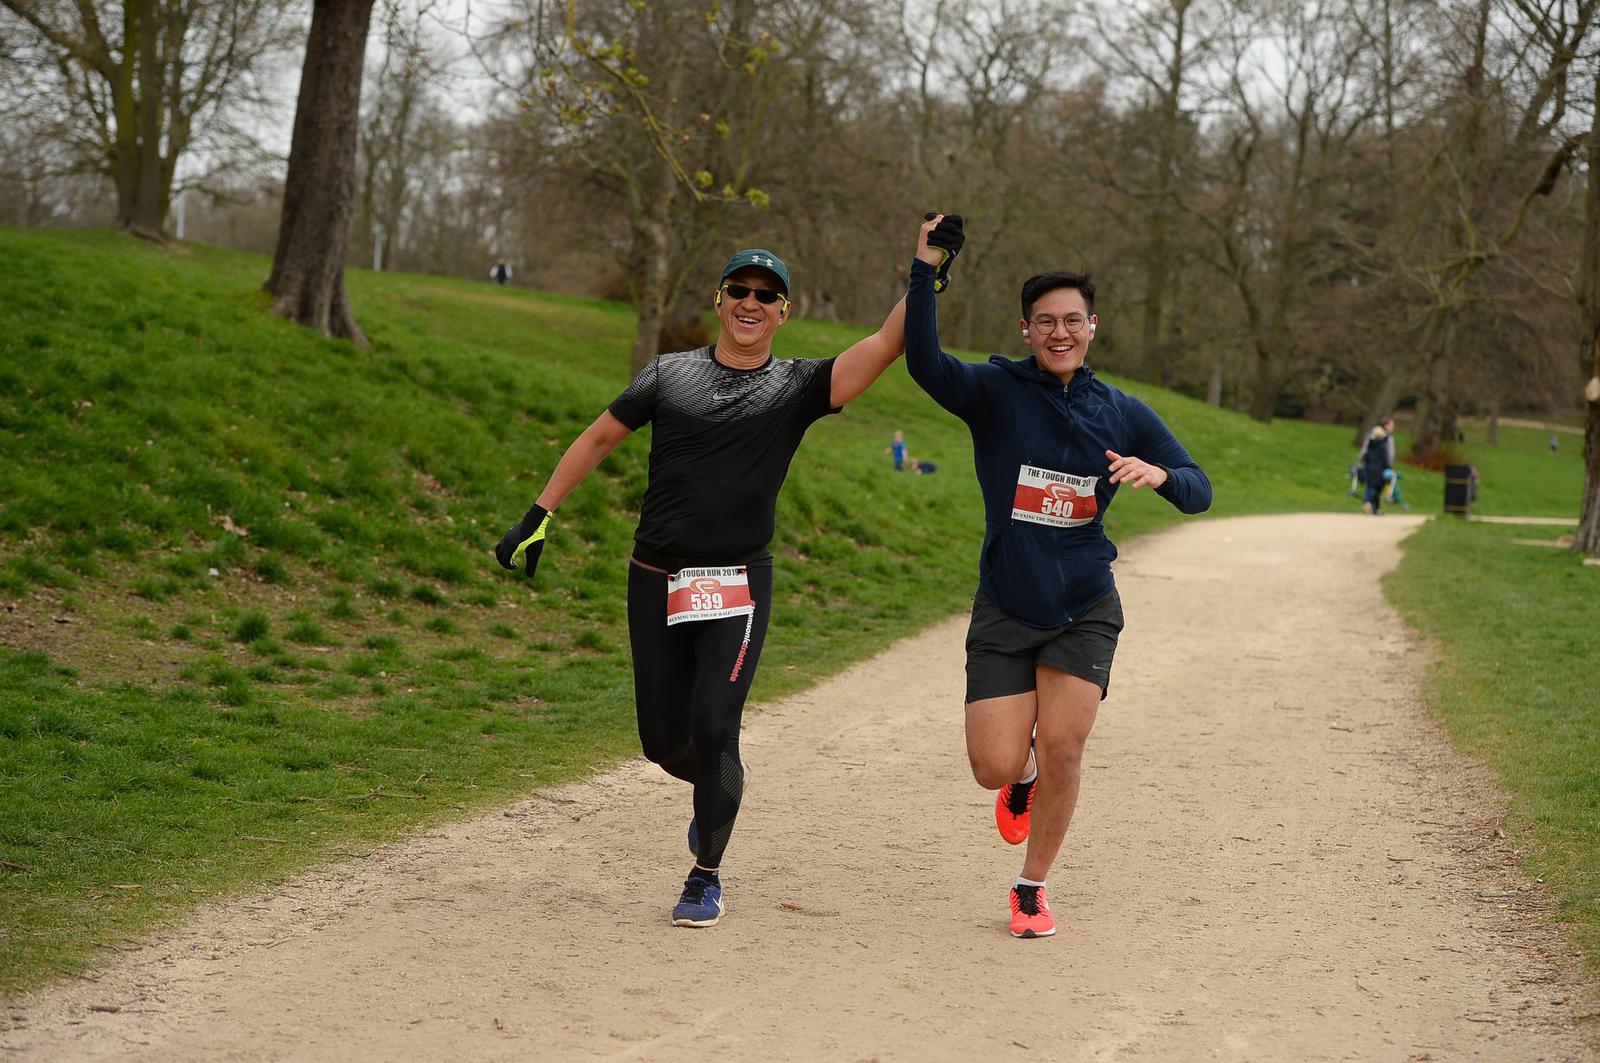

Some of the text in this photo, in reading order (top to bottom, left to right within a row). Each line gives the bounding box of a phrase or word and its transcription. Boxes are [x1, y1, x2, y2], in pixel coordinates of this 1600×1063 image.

[1028, 468, 1040, 478] THE
[1041, 471, 1065, 483] TOUGH
[1066, 475, 1081, 487] RUN
[1041, 497, 1074, 518] 540
[682, 568, 706, 578] TOUGH
[707, 568, 722, 578] RUN
[723, 567, 739, 577] 2019
[690, 593, 723, 611] 539
